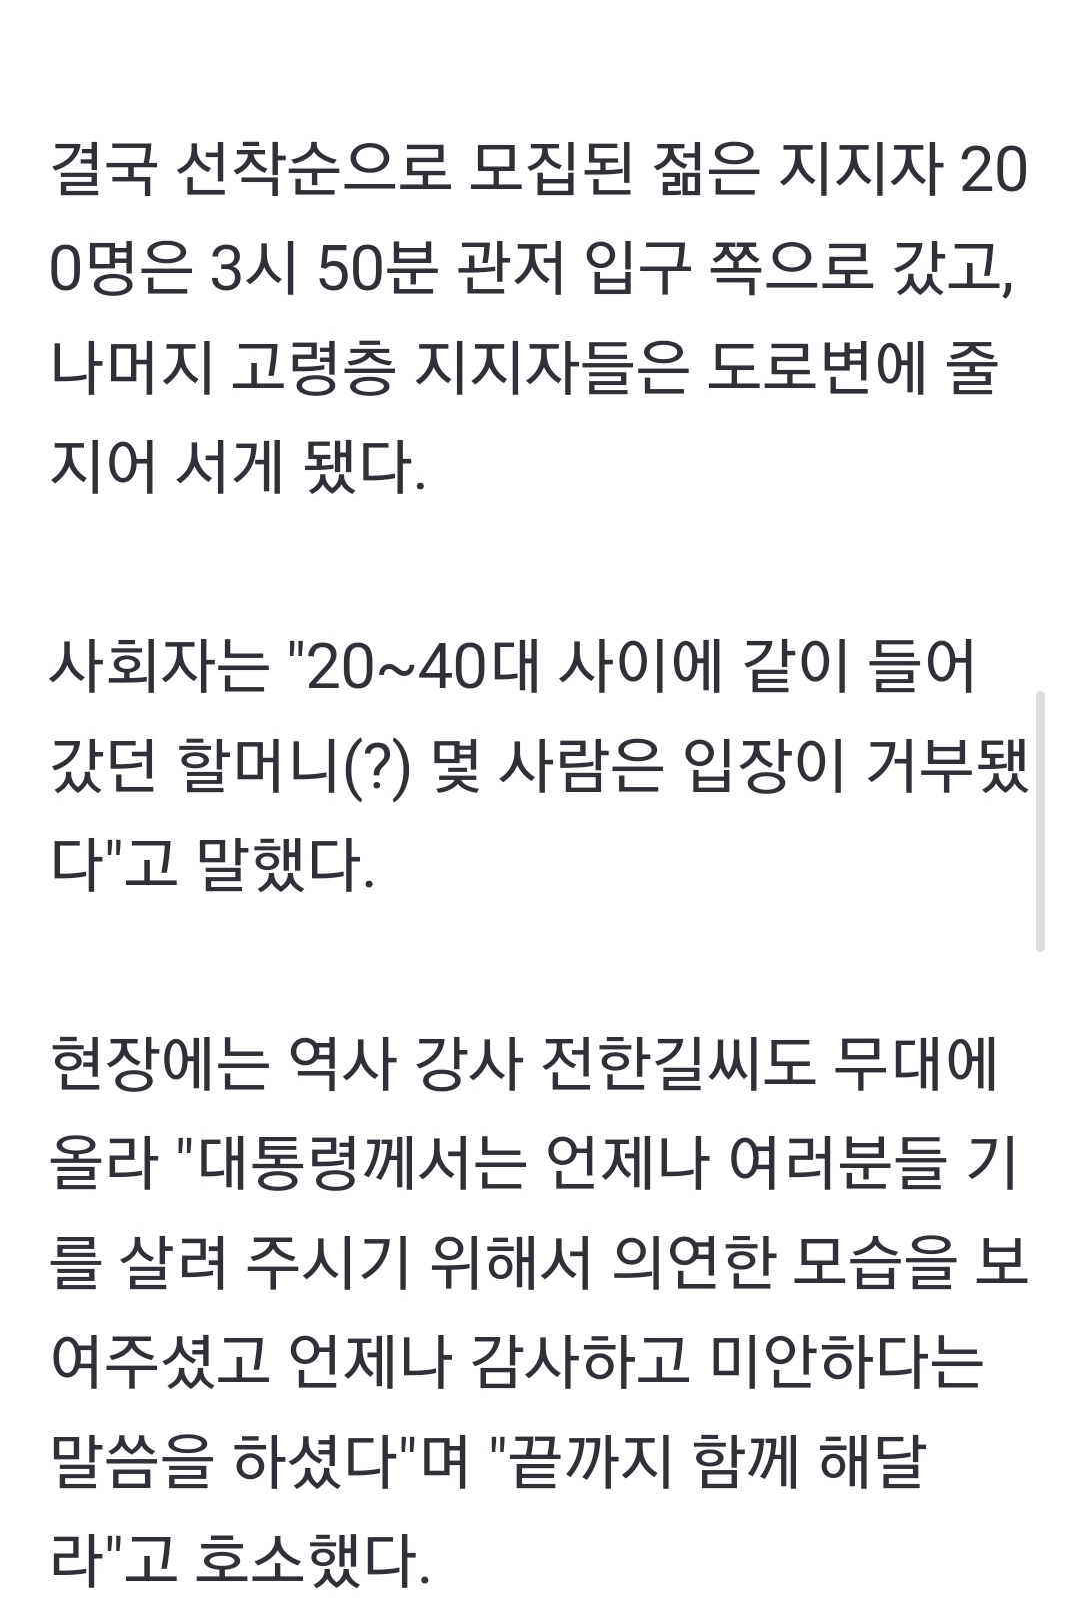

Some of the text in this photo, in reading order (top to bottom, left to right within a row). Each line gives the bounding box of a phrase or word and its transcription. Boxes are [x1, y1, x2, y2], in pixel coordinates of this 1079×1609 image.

[51, 140, 1028, 198] 결국 선착순으로 모집된 젊은 지지자 20
[53, 339, 1000, 398] 나머지 고령층 지지자들은 도로변에 줄
[50, 438, 426, 496] 지어 서게 됐다.
[47, 637, 973, 695] 사회자는 "20~40대 사이에 같이 들어
[53, 836, 374, 894] 다"고 말했다.
[51, 1035, 996, 1094] 현장에는 역사 강사 전한길씨도 무대에
[49, 1133, 1015, 1193] 올라 "대통령께서는 언제나 여러분들 기
[52, 1333, 985, 1391] 여주셨고 언제나 감사하고 미안하다는
[52, 1532, 430, 1590] 라"고 호소했다.
